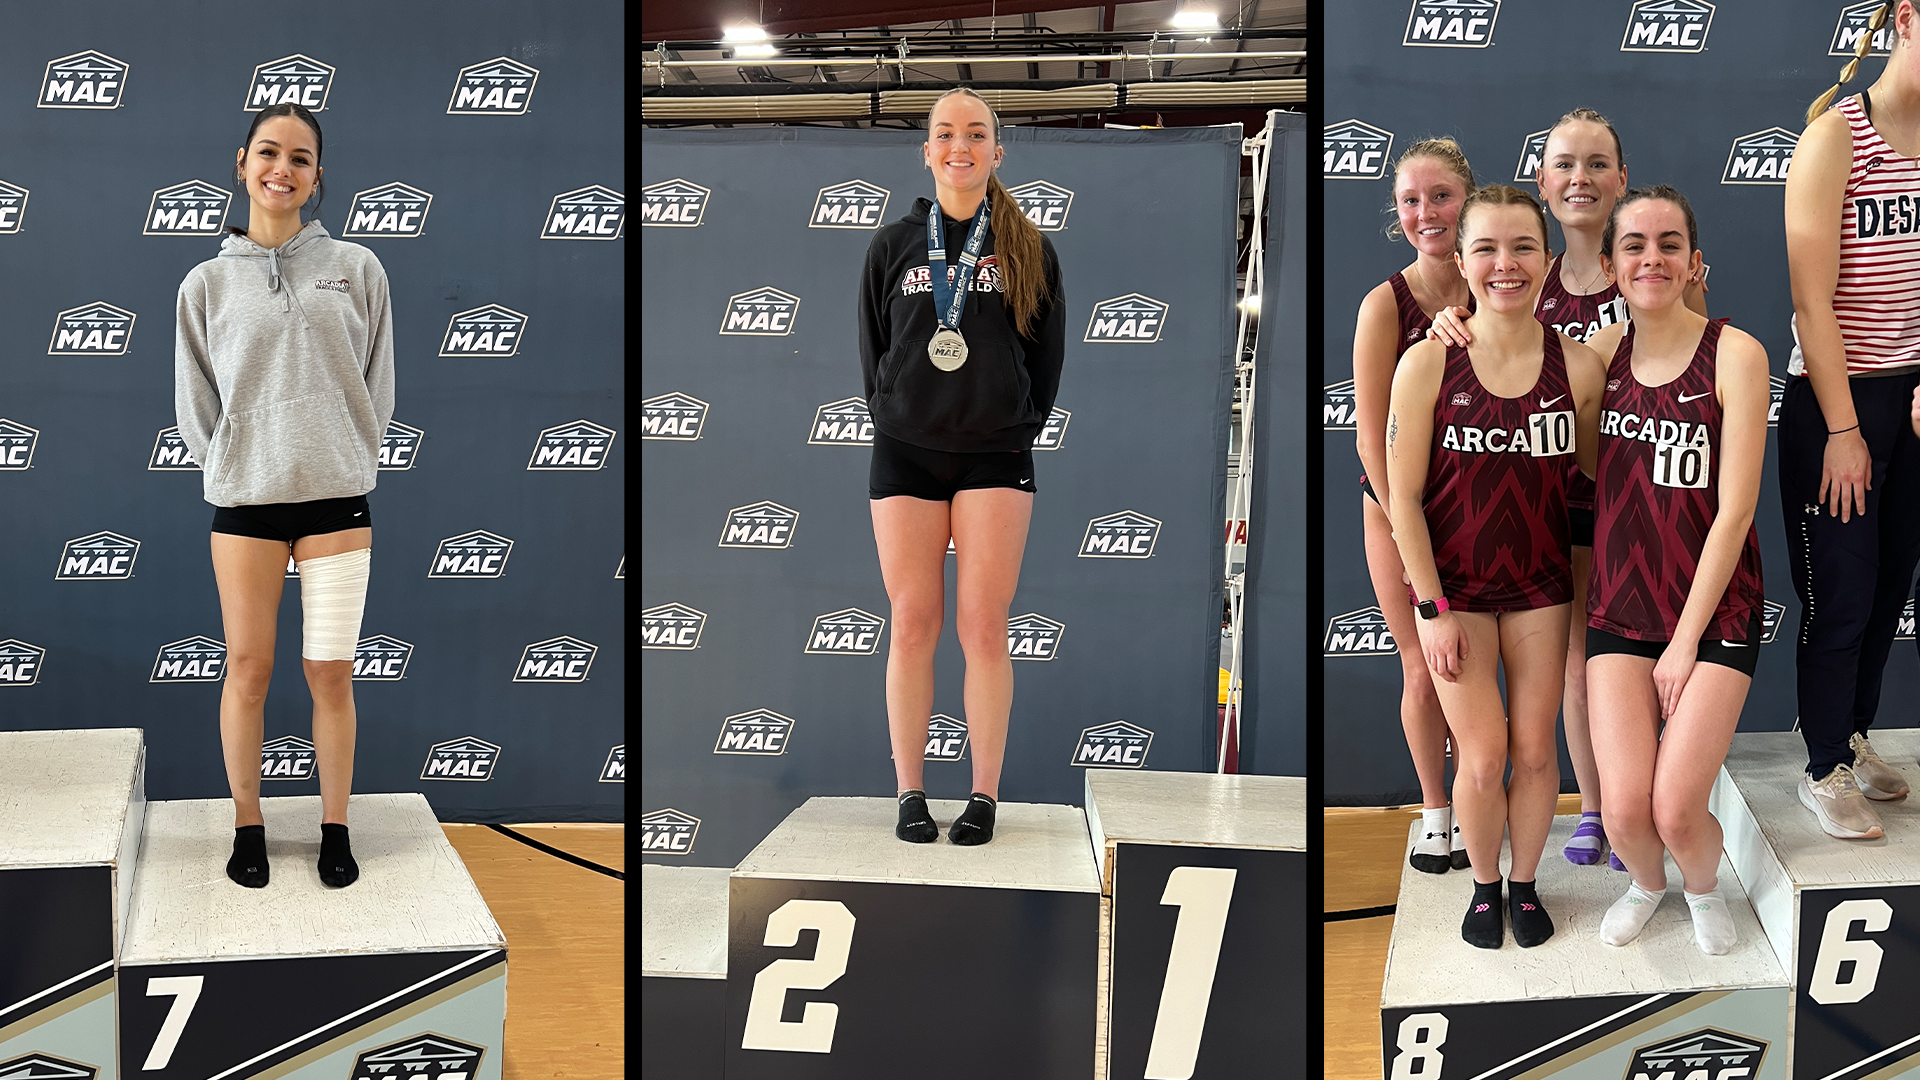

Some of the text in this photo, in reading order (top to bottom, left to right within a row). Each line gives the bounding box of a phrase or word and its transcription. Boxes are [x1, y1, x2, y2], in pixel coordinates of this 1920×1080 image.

[1412, 17, 1489, 41] MAC
[1630, 22, 1704, 46] MAC
[46, 81, 117, 102] MAC
[253, 84, 324, 106] MAC
[456, 87, 526, 108] MAC
[152, 209, 221, 230] MAC
[351, 210, 421, 231] MAC
[642, 203, 700, 222] MAC
[817, 205, 879, 224] MAC
[1019, 206, 1064, 226] AC
[549, 213, 619, 234] MAC
[902, 265, 994, 287] ARAA
[902, 284, 933, 297] TRAC
[728, 312, 790, 331] MAC
[1092, 319, 1157, 338] MAC
[57, 330, 125, 350] MAC
[448, 331, 516, 350] MAC
[642, 417, 699, 436] MAC
[816, 421, 875, 441] MAC
[1534, 413, 1571, 454] 10
[1442, 424, 1532, 453] ARCA
[156, 446, 199, 465] MA
[379, 446, 413, 465] AC
[536, 447, 604, 465] MAC
[1659, 446, 1702, 487] 10
[727, 525, 790, 543] MAC
[1086, 535, 1151, 554] MAC
[64, 556, 130, 575] MAC
[436, 556, 503, 573] MAC
[813, 632, 875, 650] MAC
[1329, 631, 1395, 652] MAC
[0, 664, 36, 681] AC
[158, 660, 222, 677] MAC
[521, 660, 587, 677] MAC
[722, 732, 785, 750] MAC
[925, 738, 962, 756] AC
[1079, 744, 1143, 763] MAC
[428, 758, 491, 777] MAC
[1808, 898, 1894, 1005] 6
[741, 899, 857, 1054] 2
[1143, 866, 1238, 1080] 1
[142, 975, 204, 1071] 7
[1390, 1012, 1450, 1080] 8
